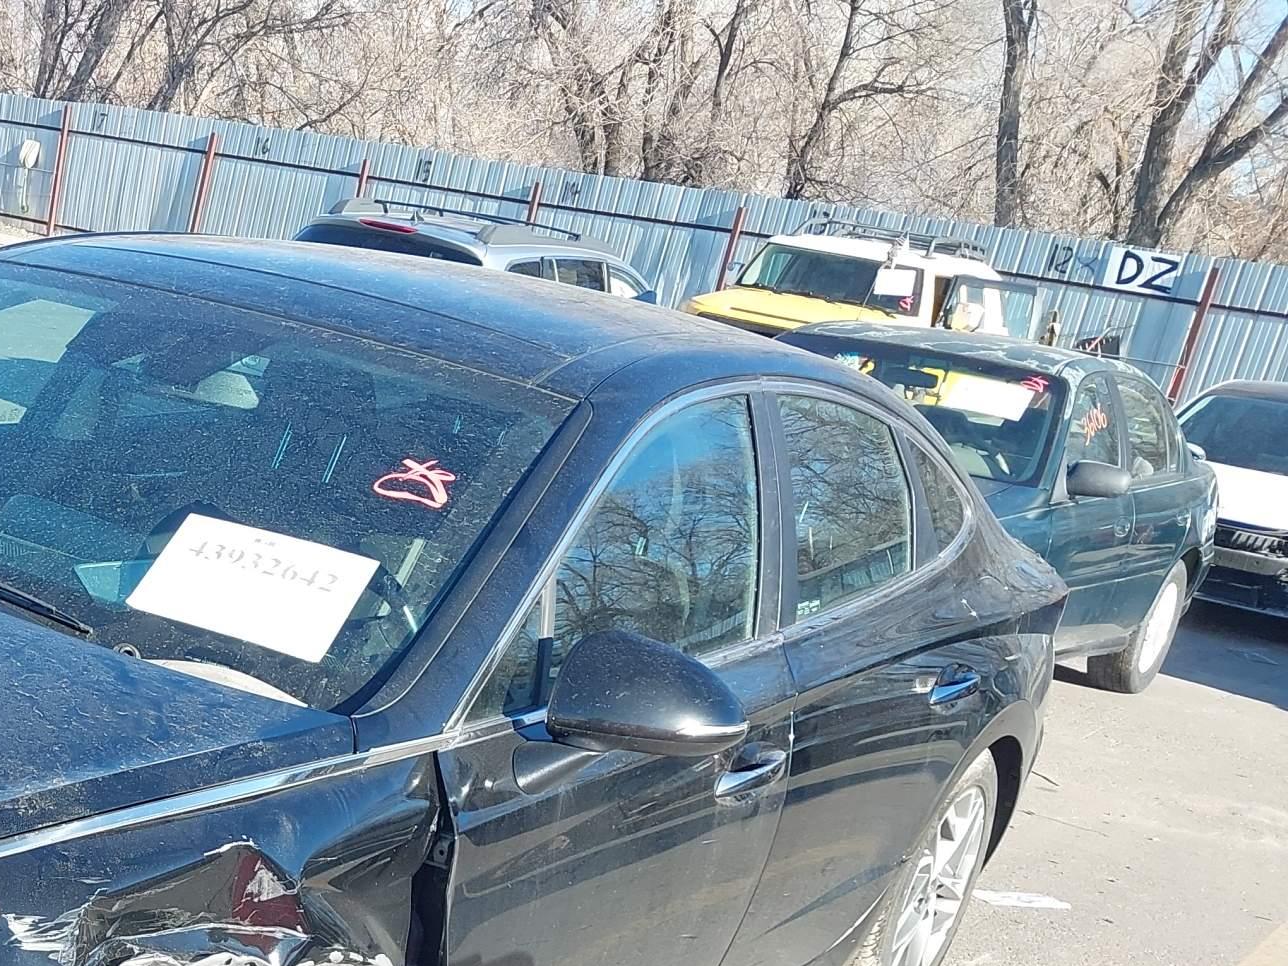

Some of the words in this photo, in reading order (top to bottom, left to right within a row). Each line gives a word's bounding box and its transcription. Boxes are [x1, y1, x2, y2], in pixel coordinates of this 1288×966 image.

[254, 136, 271, 156] 16
[1047, 243, 1074, 274] 12
[1116, 249, 1179, 295] DZ
[188, 540, 339, 593] 43932642
